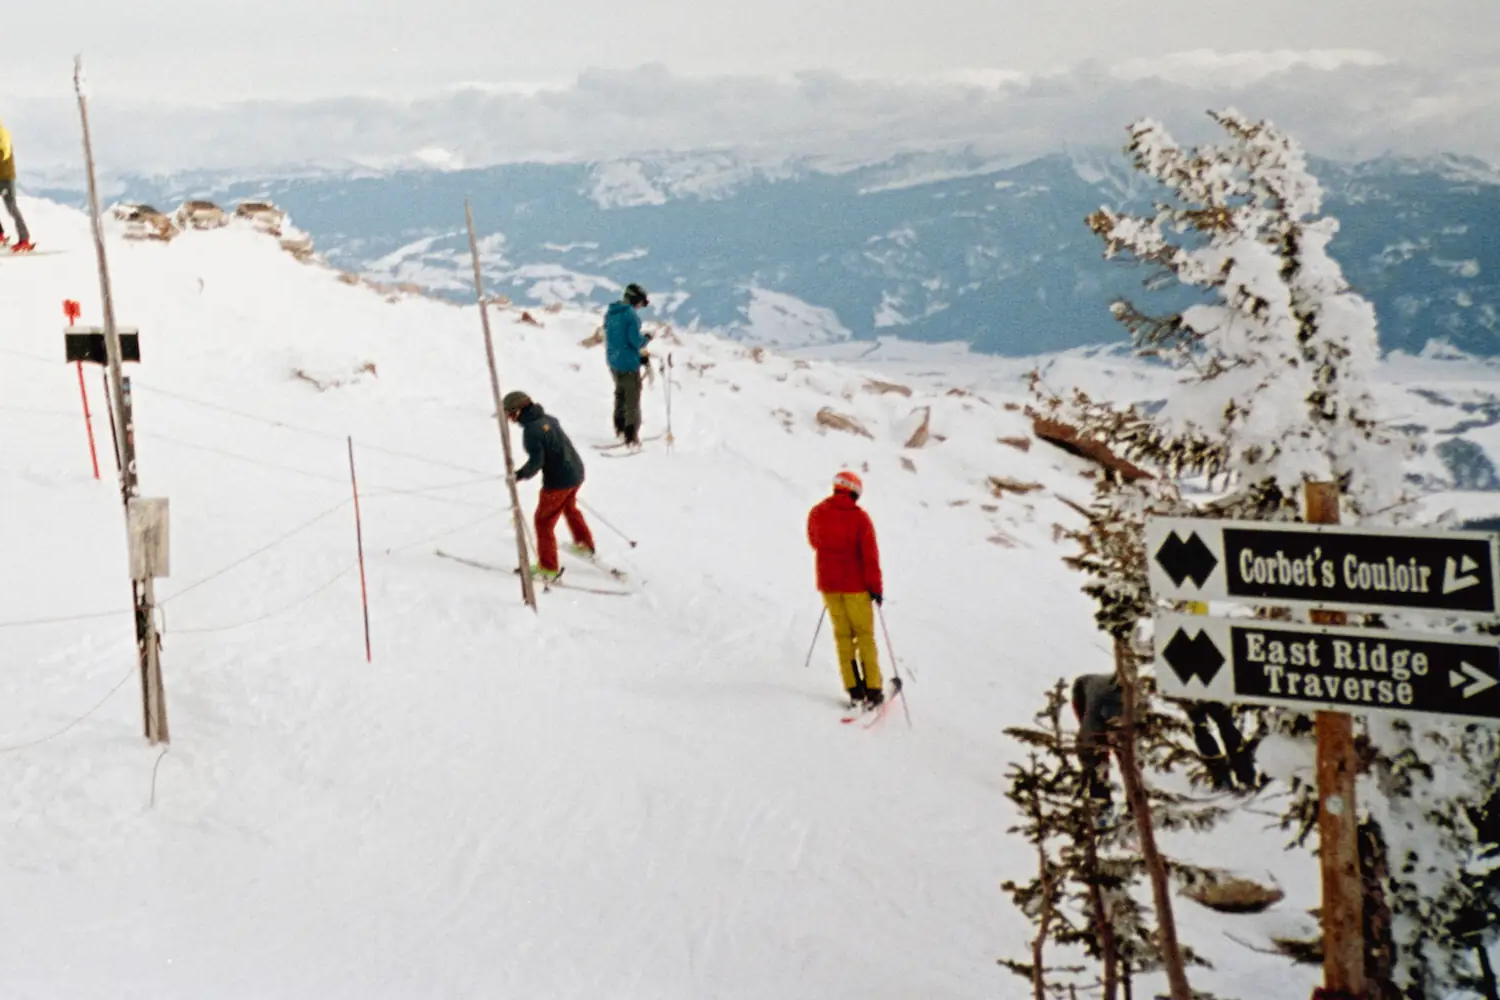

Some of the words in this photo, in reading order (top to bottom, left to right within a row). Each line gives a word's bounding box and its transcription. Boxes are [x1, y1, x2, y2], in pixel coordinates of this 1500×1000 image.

[1239, 546, 1336, 588] Corbet's
[1343, 553, 1431, 593] Couloir
[1245, 633, 1321, 667] East
[1332, 639, 1429, 681] Ridge
[1263, 664, 1414, 705] Traverse
